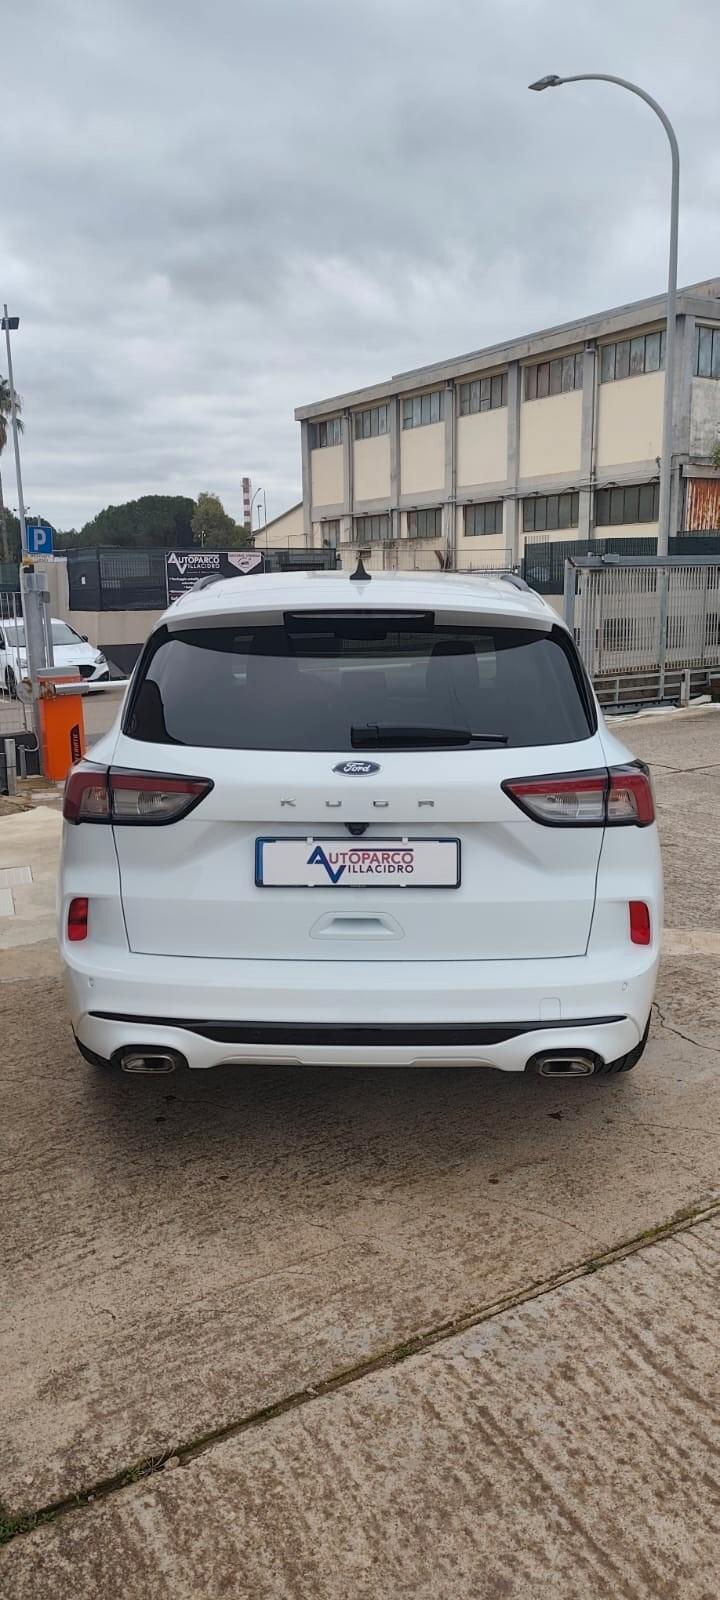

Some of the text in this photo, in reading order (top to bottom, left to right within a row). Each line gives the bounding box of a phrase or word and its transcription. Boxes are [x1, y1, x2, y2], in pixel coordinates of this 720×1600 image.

[33, 528, 47, 551] P
[168, 552, 220, 564] AUTOPARCO
[177, 563, 221, 575] VILLACIDRO
[343, 762, 371, 773] Ford
[280, 798, 435, 808] KUGA
[306, 846, 414, 865] AUTOPARCO
[322, 864, 414, 884] VILLACIDRO
